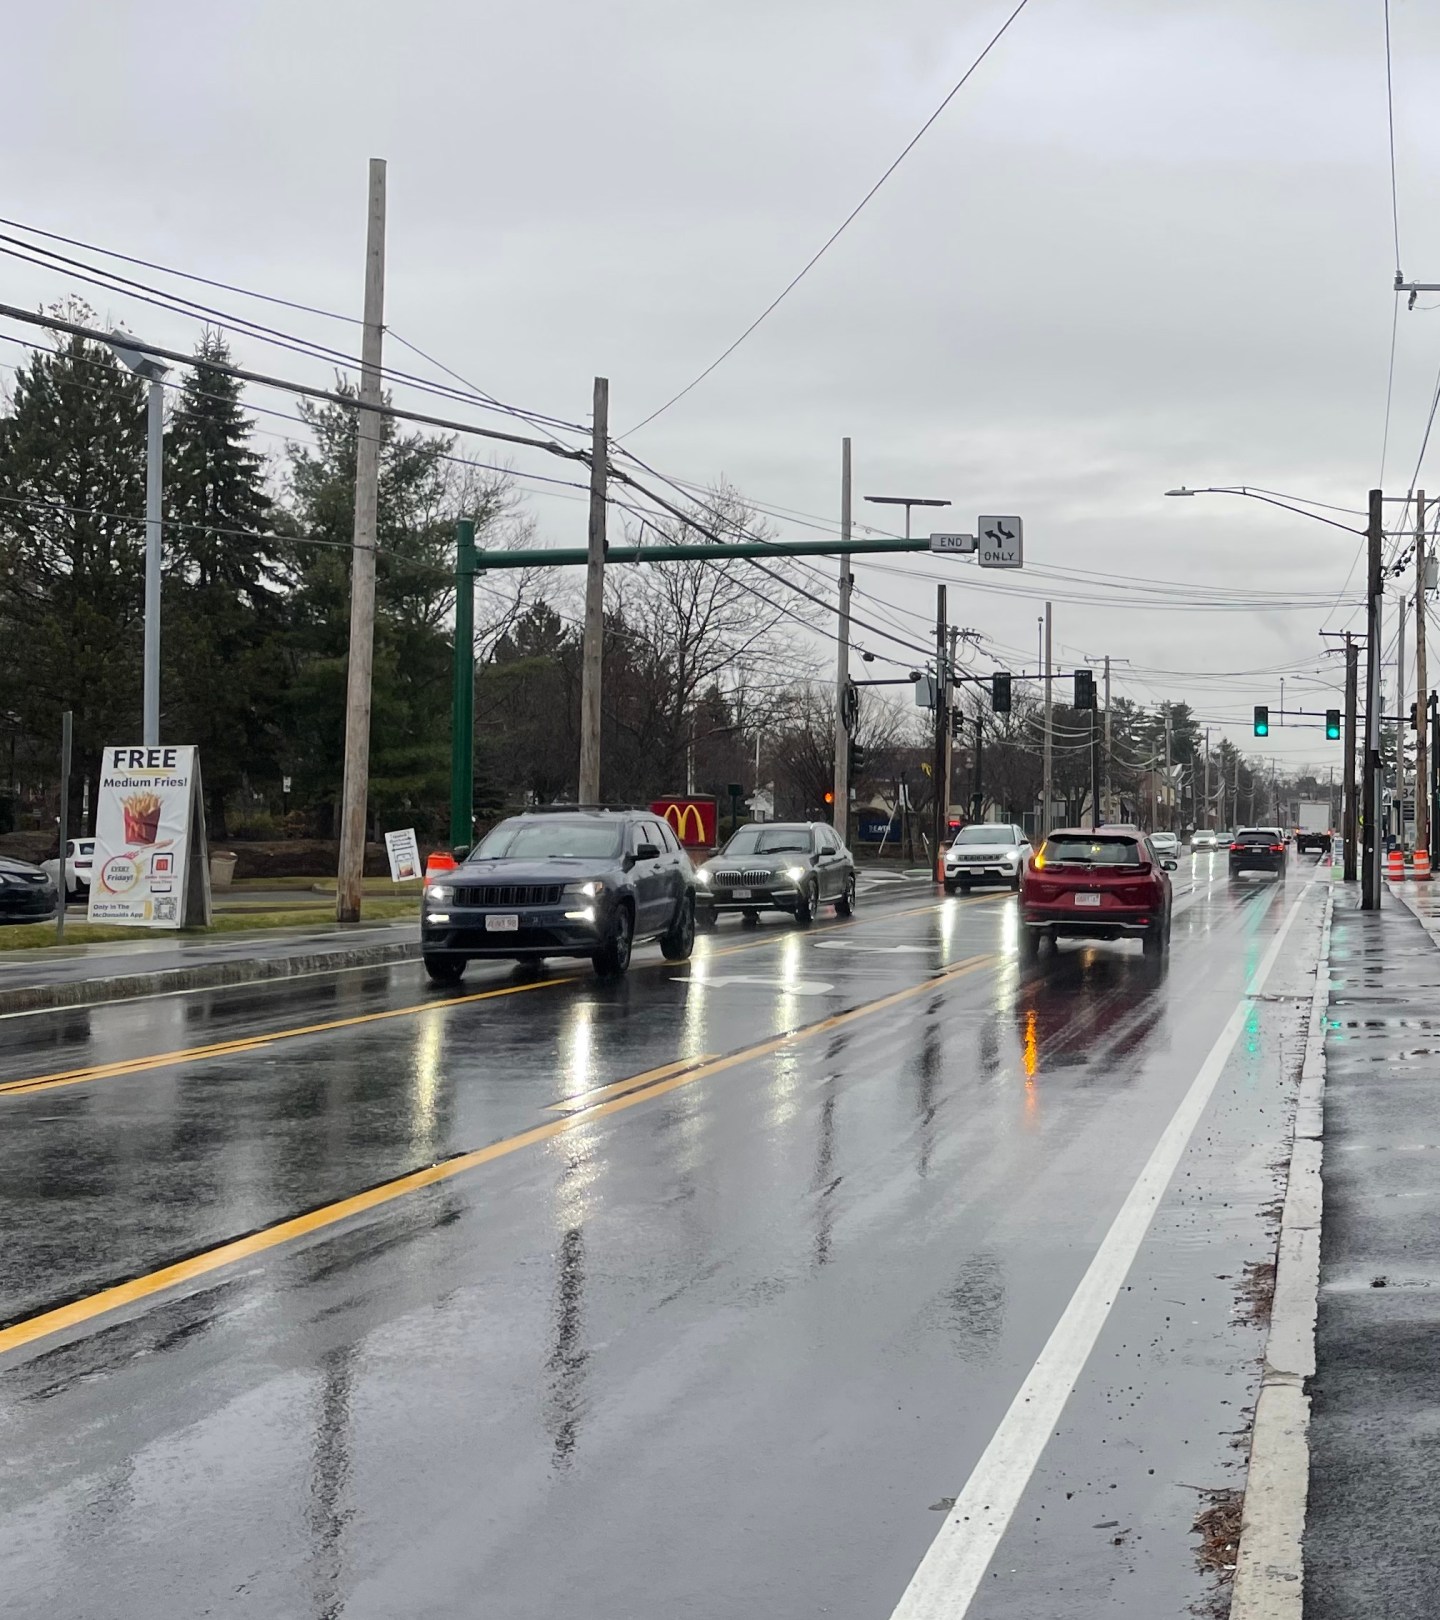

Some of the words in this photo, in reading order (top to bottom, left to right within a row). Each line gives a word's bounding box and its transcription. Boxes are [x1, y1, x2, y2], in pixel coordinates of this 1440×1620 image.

[940, 537, 962, 547] END
[984, 552, 1014, 561] ONLY
[113, 749, 177, 768] FREE
[104, 778, 151, 788] Medium
[154, 777, 188, 787] Fries!
[107, 874, 134, 882] Friday!
